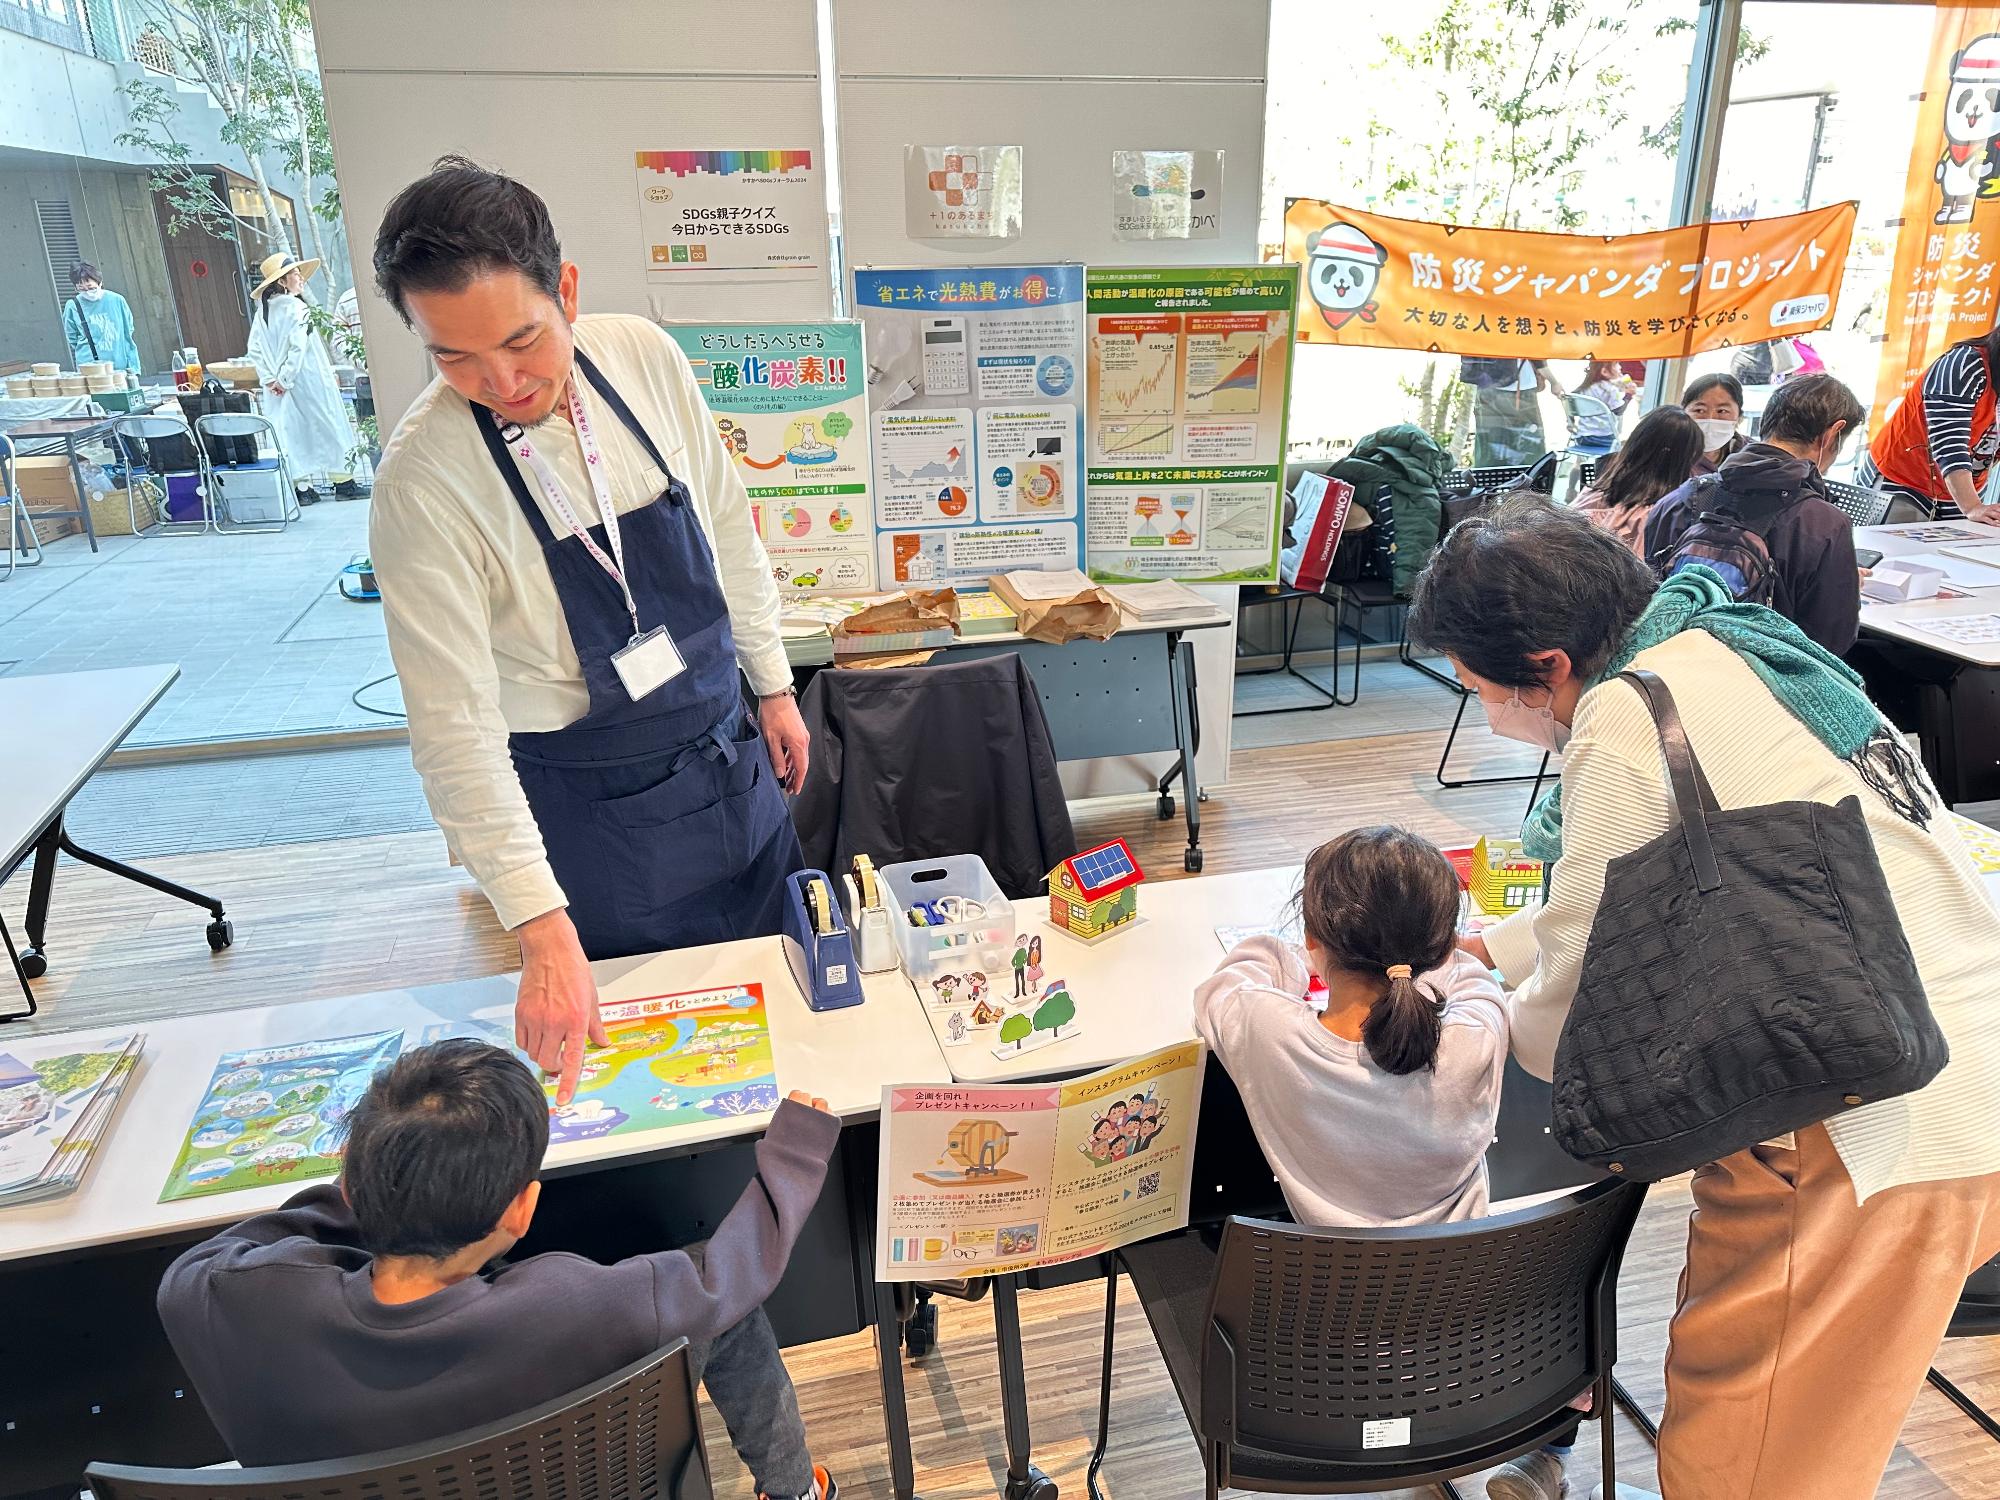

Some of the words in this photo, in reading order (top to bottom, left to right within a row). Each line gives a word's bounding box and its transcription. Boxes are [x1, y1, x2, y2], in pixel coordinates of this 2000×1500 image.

[682, 206, 776, 220] SDGs親子クイズ
[671, 223, 790, 236] 今日からできるSDGs
[1927, 232, 1981, 262] 防災
[1912, 261, 1996, 285] ジャパンダ
[877, 279, 1064, 303] 省エネで光熱費がお得に!
[1959, 312, 1988, 324] Project
[700, 333, 825, 349] どうしたらへらせる
[689, 355, 847, 390] 二酸化炭素!!
[1330, 490, 1350, 529] SOMPO
[1078, 1055, 1181, 1097] インスタグラムキャンペーン!
